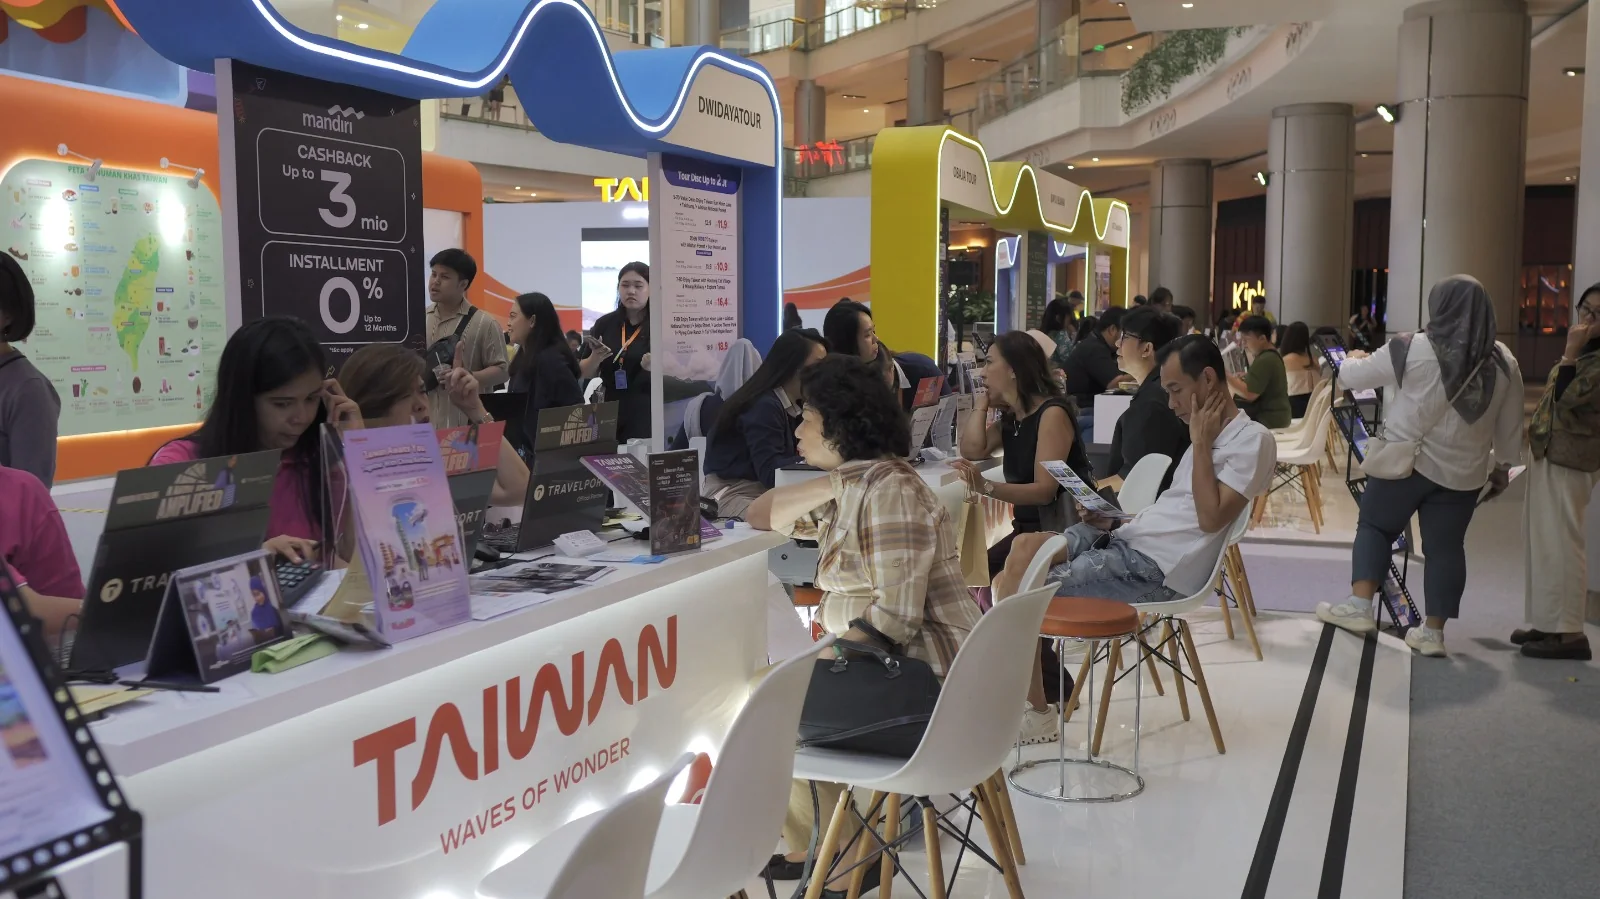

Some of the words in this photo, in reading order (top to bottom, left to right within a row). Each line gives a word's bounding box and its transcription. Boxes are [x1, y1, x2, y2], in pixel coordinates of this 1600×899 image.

[302, 112, 353, 134] mandiri
[698, 96, 762, 129] DWIDAYATOUR
[298, 144, 372, 168] CASHBACK
[68, 166, 85, 174] PETA
[124, 172, 140, 180] KHAS
[140, 174, 168, 184] TAIWAN
[678, 171, 690, 181] Tour
[690, 172, 702, 183] Disc
[702, 175, 710, 186] Up
[710, 177, 716, 186] to
[716, 174, 722, 186] 2
[966, 172, 977, 185] TOUR
[282, 164, 300, 180] Up
[302, 168, 314, 180] to
[318, 170, 357, 228] 3
[361, 216, 388, 232] mio
[593, 176, 649, 202] TAI
[289, 254, 384, 272] INSTALLMENT
[364, 315, 374, 323] Up
[594, 456, 634, 467] TAIWAN
[548, 478, 606, 496] TRAVELPOR
[156, 489, 225, 520] AMPLIFIED
[353, 614, 678, 827] TAIWAN
[440, 796, 515, 855] WAVES
[522, 778, 548, 810] OF
[553, 737, 630, 794] WONDER
